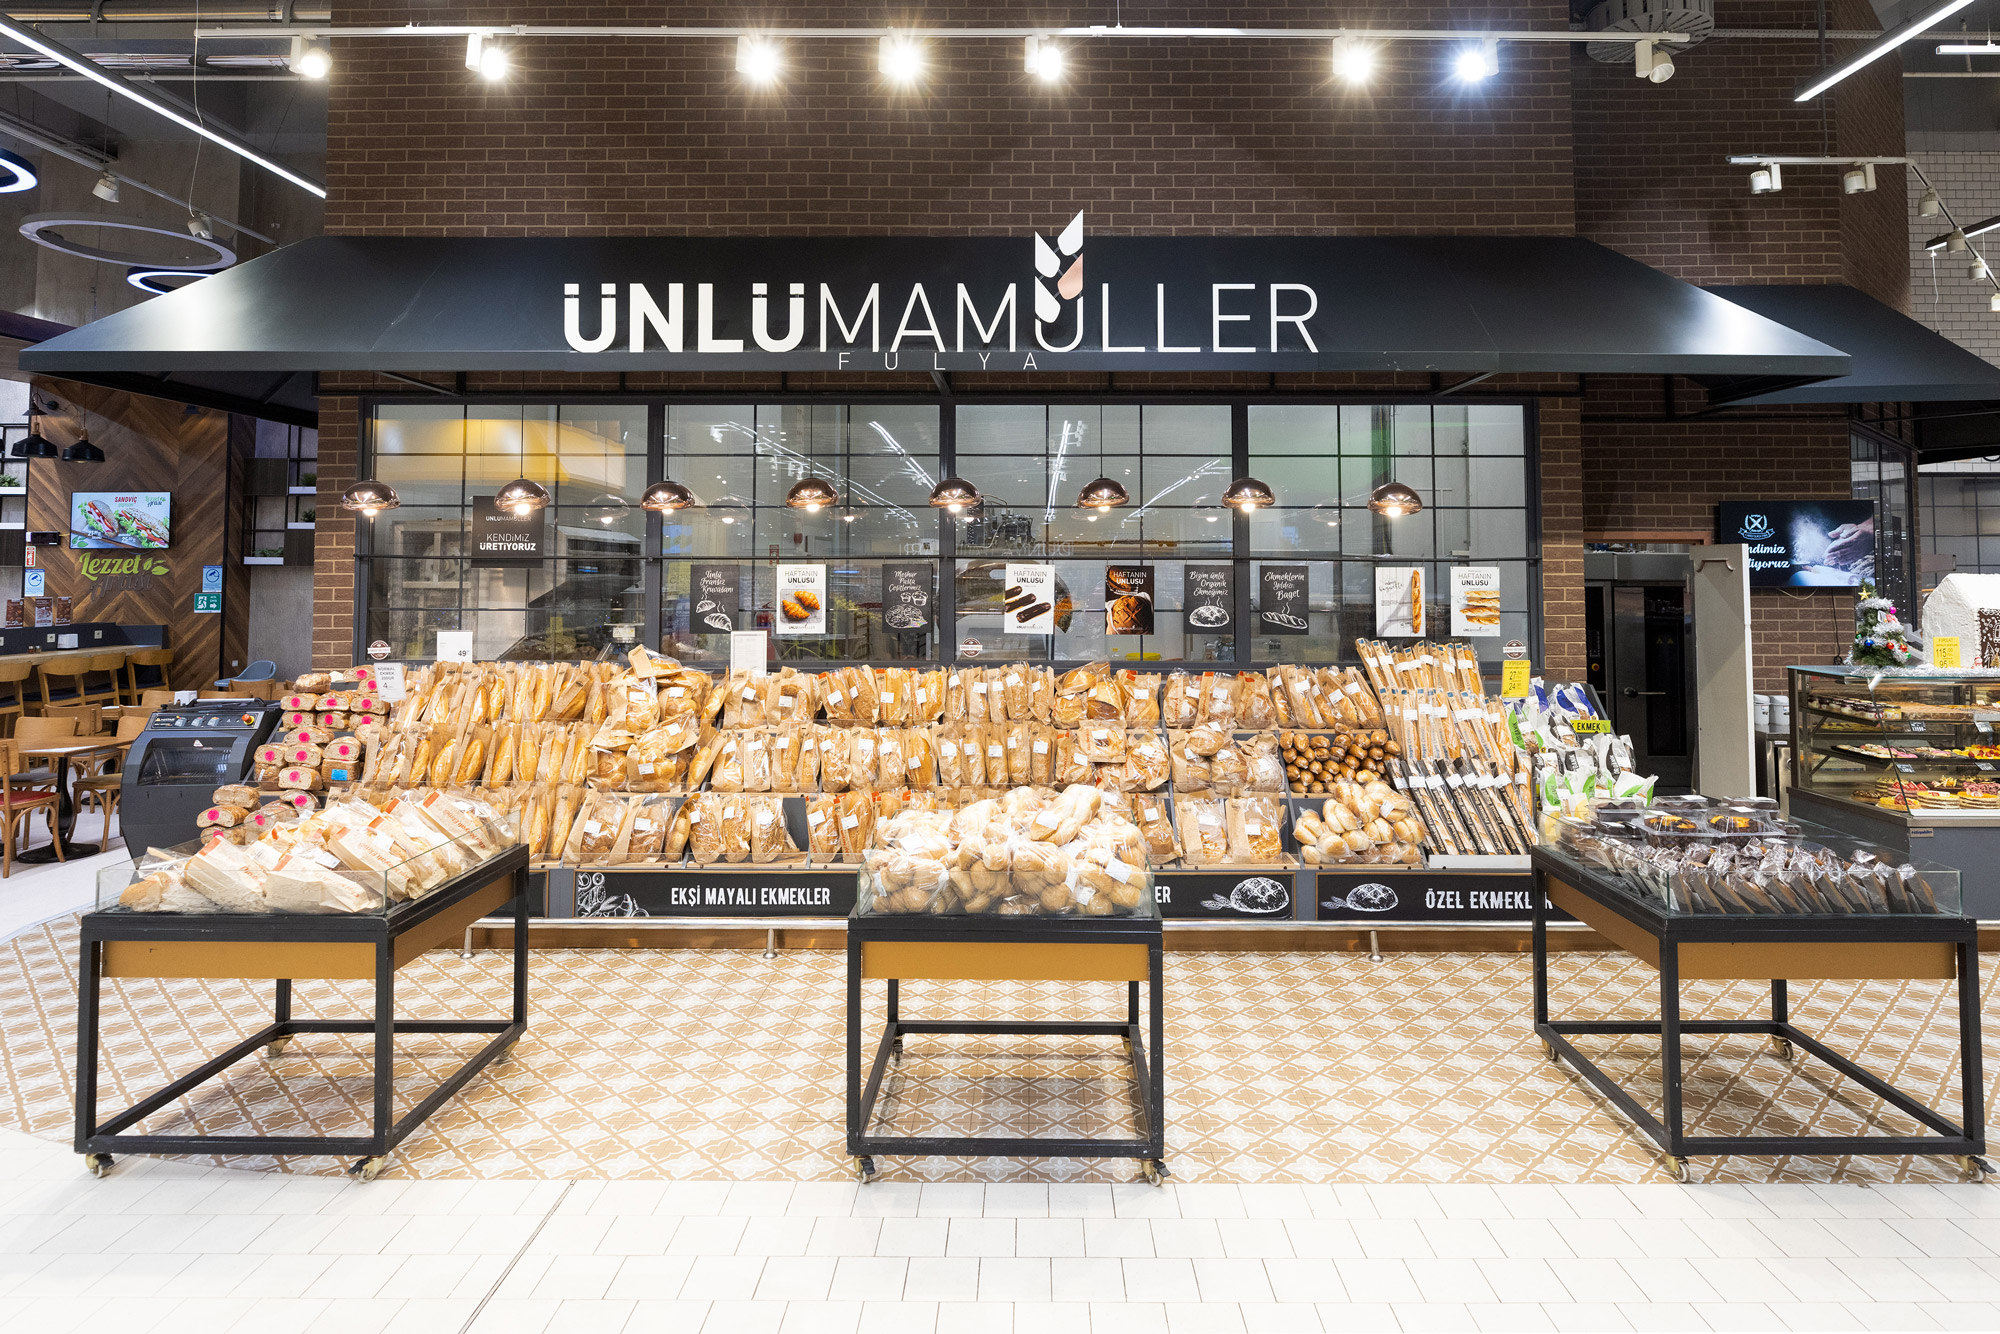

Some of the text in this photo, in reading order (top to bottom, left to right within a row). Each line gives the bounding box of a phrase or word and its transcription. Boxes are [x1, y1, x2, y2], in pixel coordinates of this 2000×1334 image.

[838, 352, 1039, 371] FULYA
[479, 542, 536, 551] ÜRETİYORUZ
[79, 552, 142, 581] Lezzet
[1264, 571, 1305, 582] Ekmeklerin
[1200, 579, 1227, 589] Organik
[1276, 589, 1300, 601] Baget
[1577, 722, 1601, 731] EKMEK
[671, 884, 831, 907] EKŞİ MAYALI EKMEKLER
[1425, 887, 1553, 909] ÖZEL EKMEKLR
